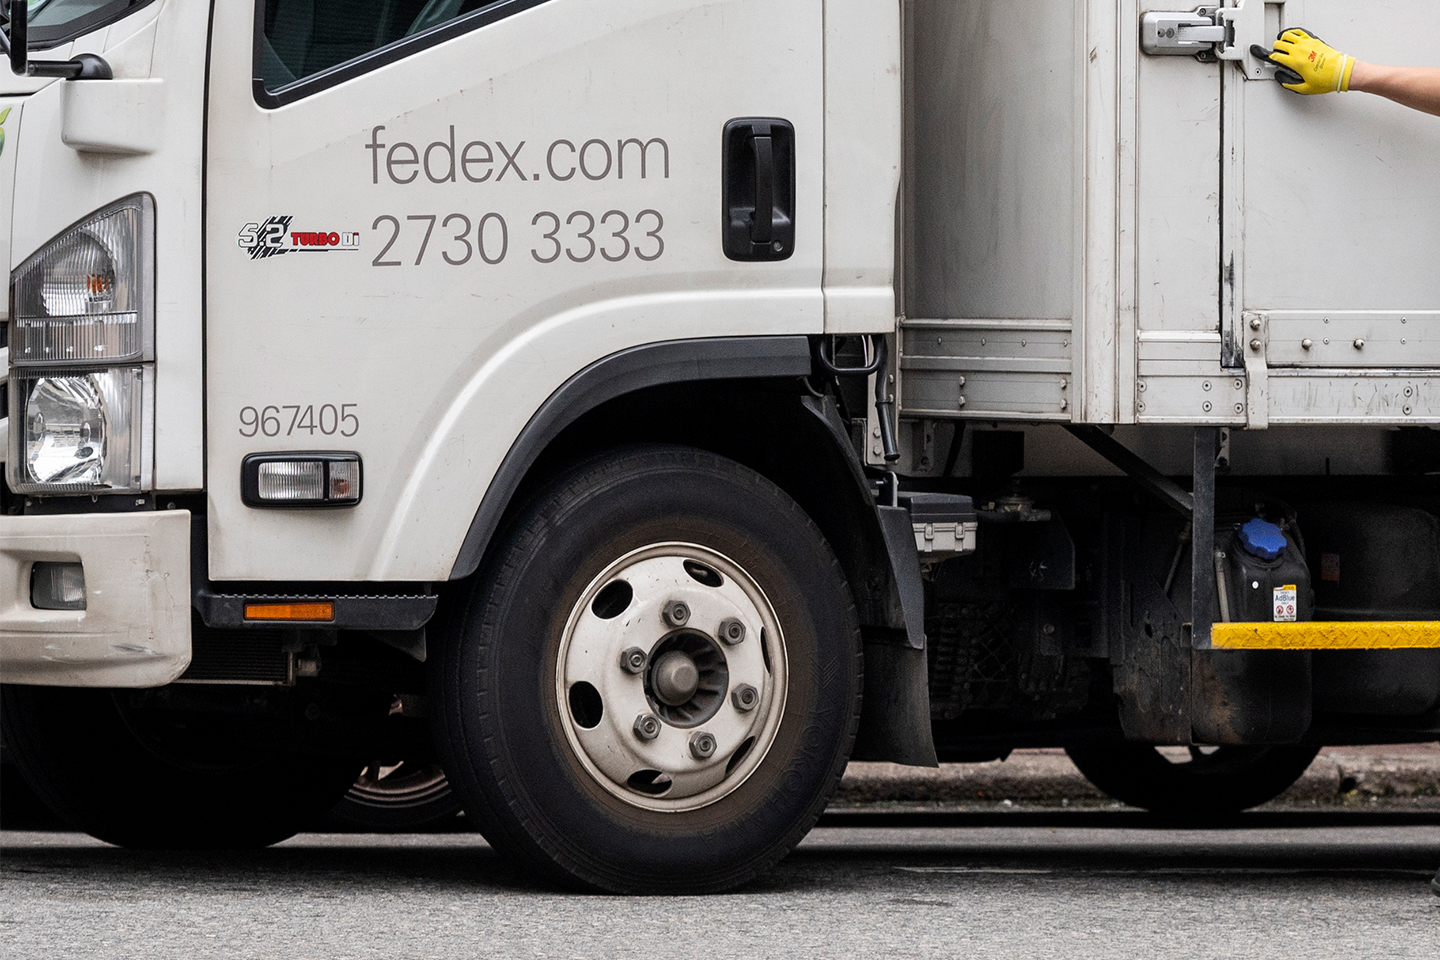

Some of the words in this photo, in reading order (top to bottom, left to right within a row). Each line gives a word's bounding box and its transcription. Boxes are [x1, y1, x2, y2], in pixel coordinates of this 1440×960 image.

[365, 125, 669, 185] fedex.com
[290, 231, 340, 246] TURBO
[372, 212, 508, 267] 2730
[530, 209, 665, 263] 3333
[238, 403, 360, 438] 967405
[1275, 594, 1295, 602] AdBlue
